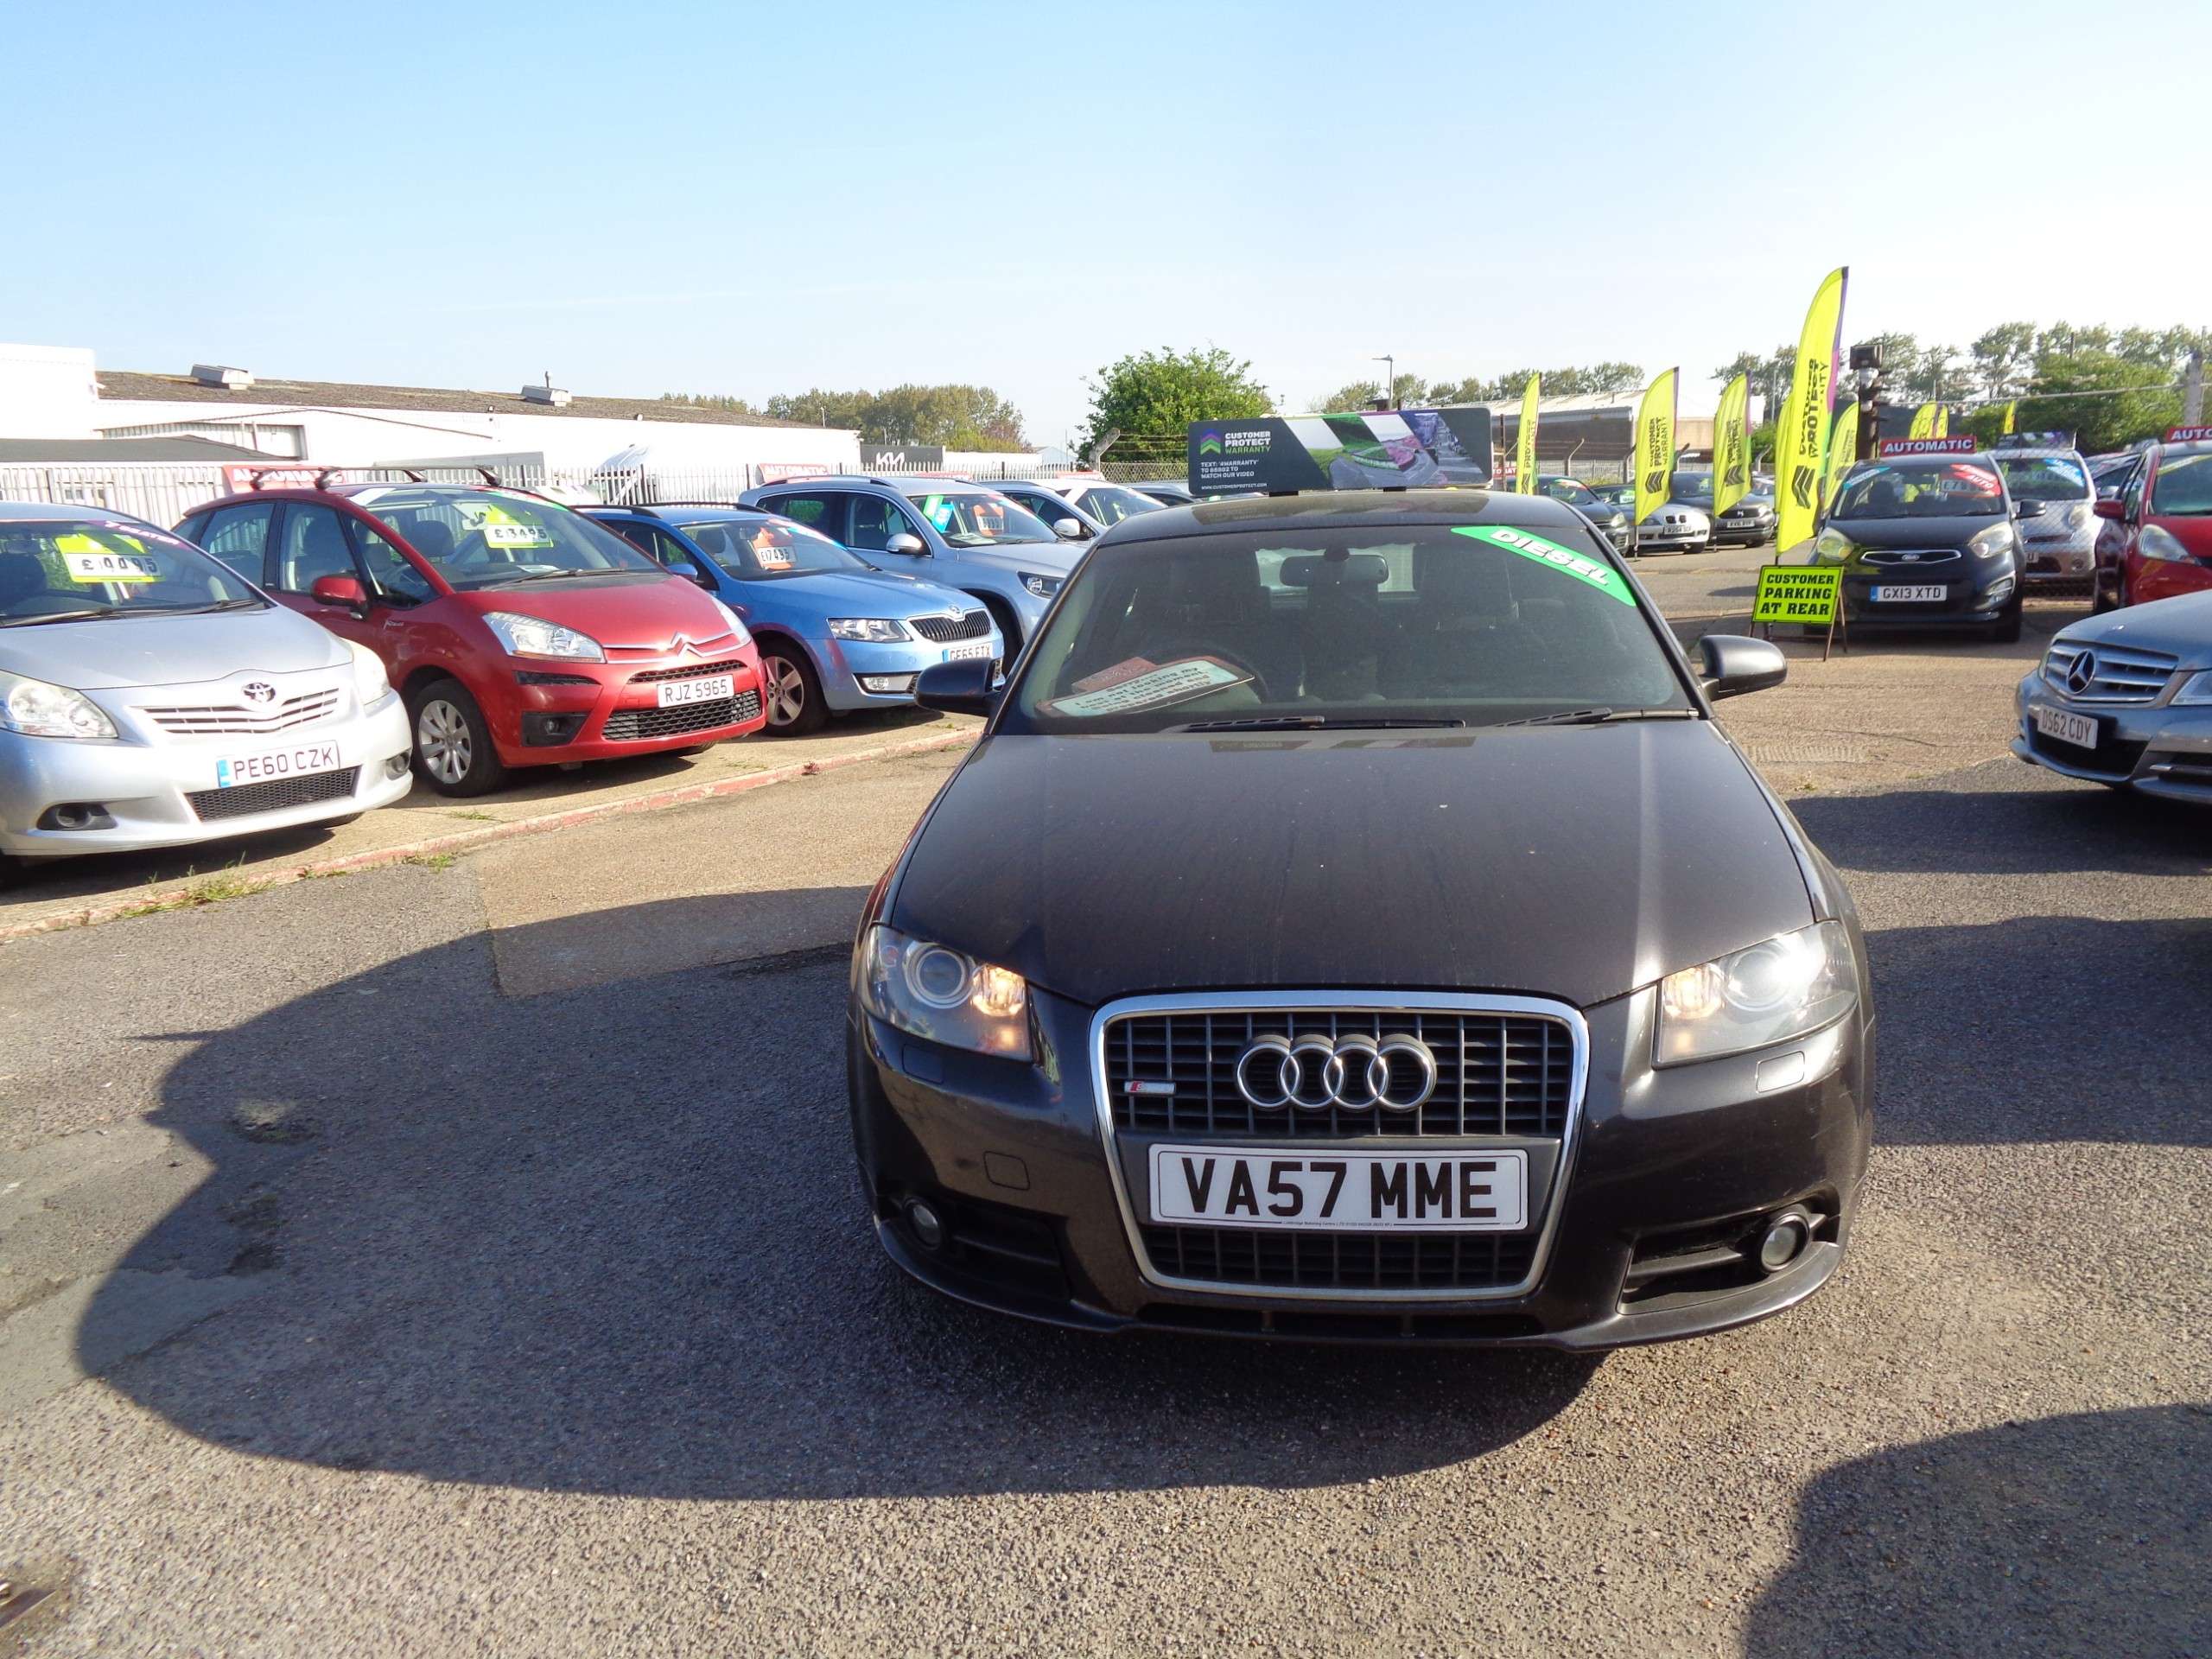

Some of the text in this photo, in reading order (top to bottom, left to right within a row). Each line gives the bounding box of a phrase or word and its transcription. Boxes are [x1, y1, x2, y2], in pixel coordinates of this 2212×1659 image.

[1224, 430, 1271, 440] CUSTOMER
[1224, 437, 1271, 448] PROTECT
[1884, 438, 1973, 454] AUTOMATIC
[1224, 445, 1272, 455] WARRANTY
[1490, 529, 1608, 586] DIESEL
[1766, 574, 1834, 584] CUSTOMER
[1764, 587, 1832, 600] PARKING
[1883, 587, 1941, 599] GX13 XTD
[1760, 602, 1830, 615] AT REAR
[664, 678, 728, 702] RJZ 5965
[2042, 709, 2091, 742] DS62 CDY
[233, 747, 334, 780] PE60 CZK
[1181, 1157, 1497, 1218] VA57 MME
